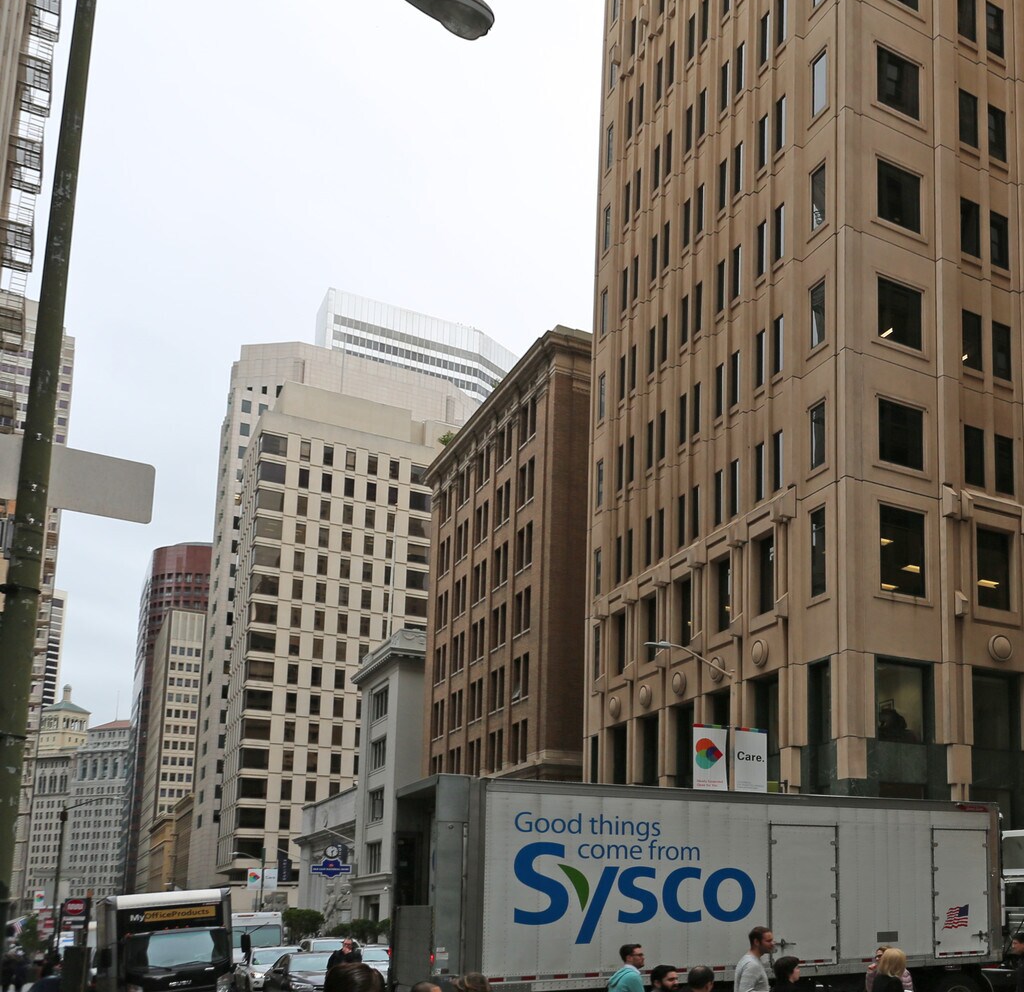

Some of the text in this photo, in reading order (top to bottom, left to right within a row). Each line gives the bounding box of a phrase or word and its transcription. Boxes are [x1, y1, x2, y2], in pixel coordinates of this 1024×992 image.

[737, 751, 765, 763] Care.
[514, 811, 662, 843] Good things
[577, 839, 701, 861] come from
[129, 908, 210, 923] MyOfficeProducts
